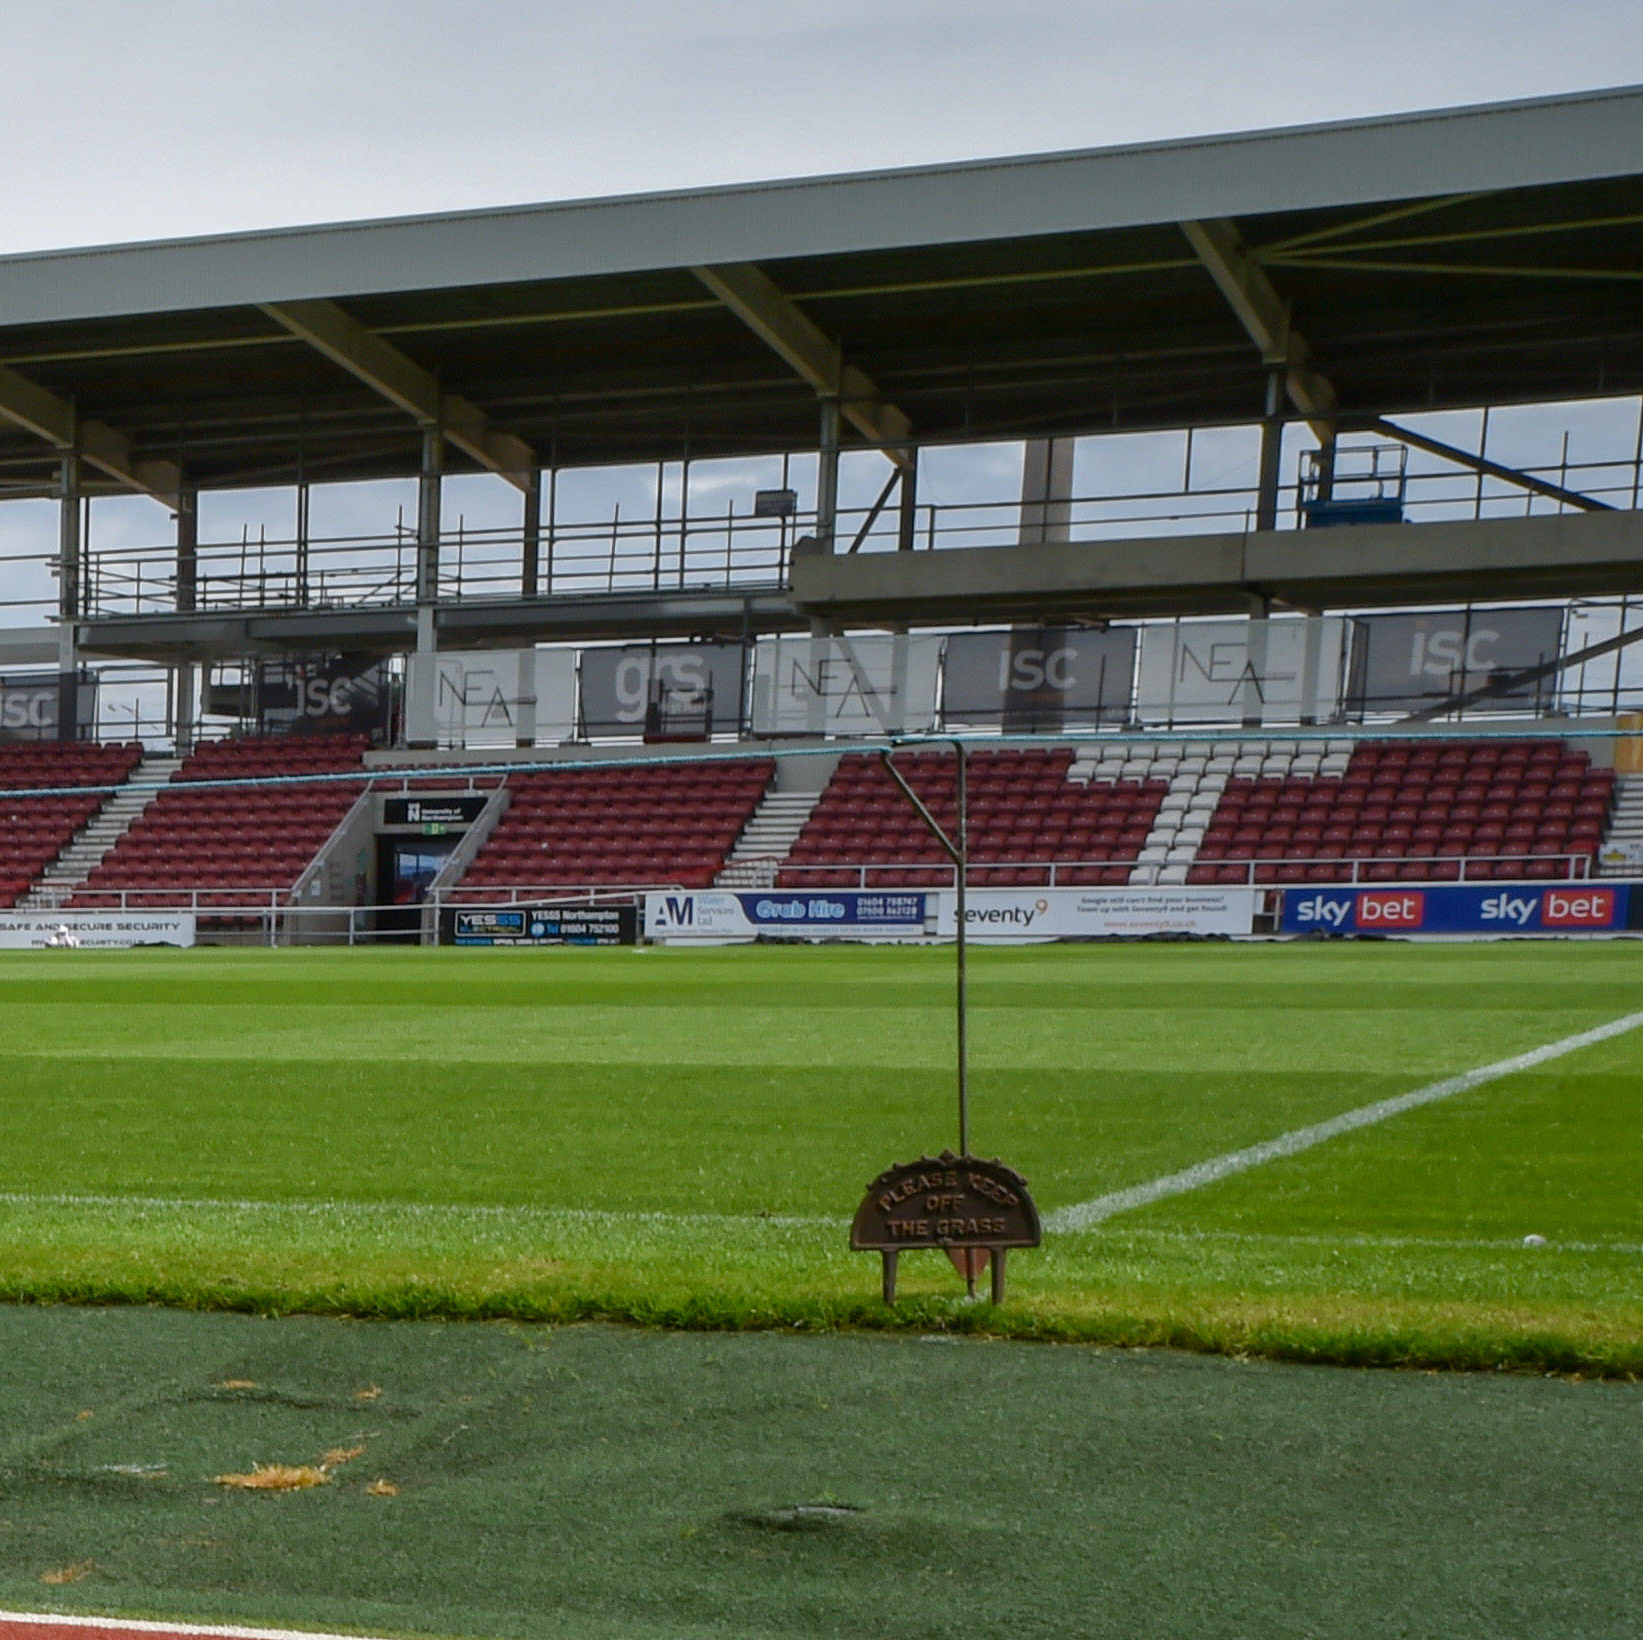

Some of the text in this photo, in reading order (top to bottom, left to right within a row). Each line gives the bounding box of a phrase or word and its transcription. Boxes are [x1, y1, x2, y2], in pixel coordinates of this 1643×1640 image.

[756, 899, 846, 918] Grab Hire
[1297, 895, 1415, 926] sky bet
[1481, 893, 1604, 924] sky bet
[0, 922, 31, 931] SAFE
[35, 922, 61, 931] AND
[117, 922, 180, 931] SECURITY
[879, 1170, 1019, 1212] PLEASE KEEP
[926, 1194, 965, 1211] OFF
[887, 1217, 1006, 1236] THE GRASS
